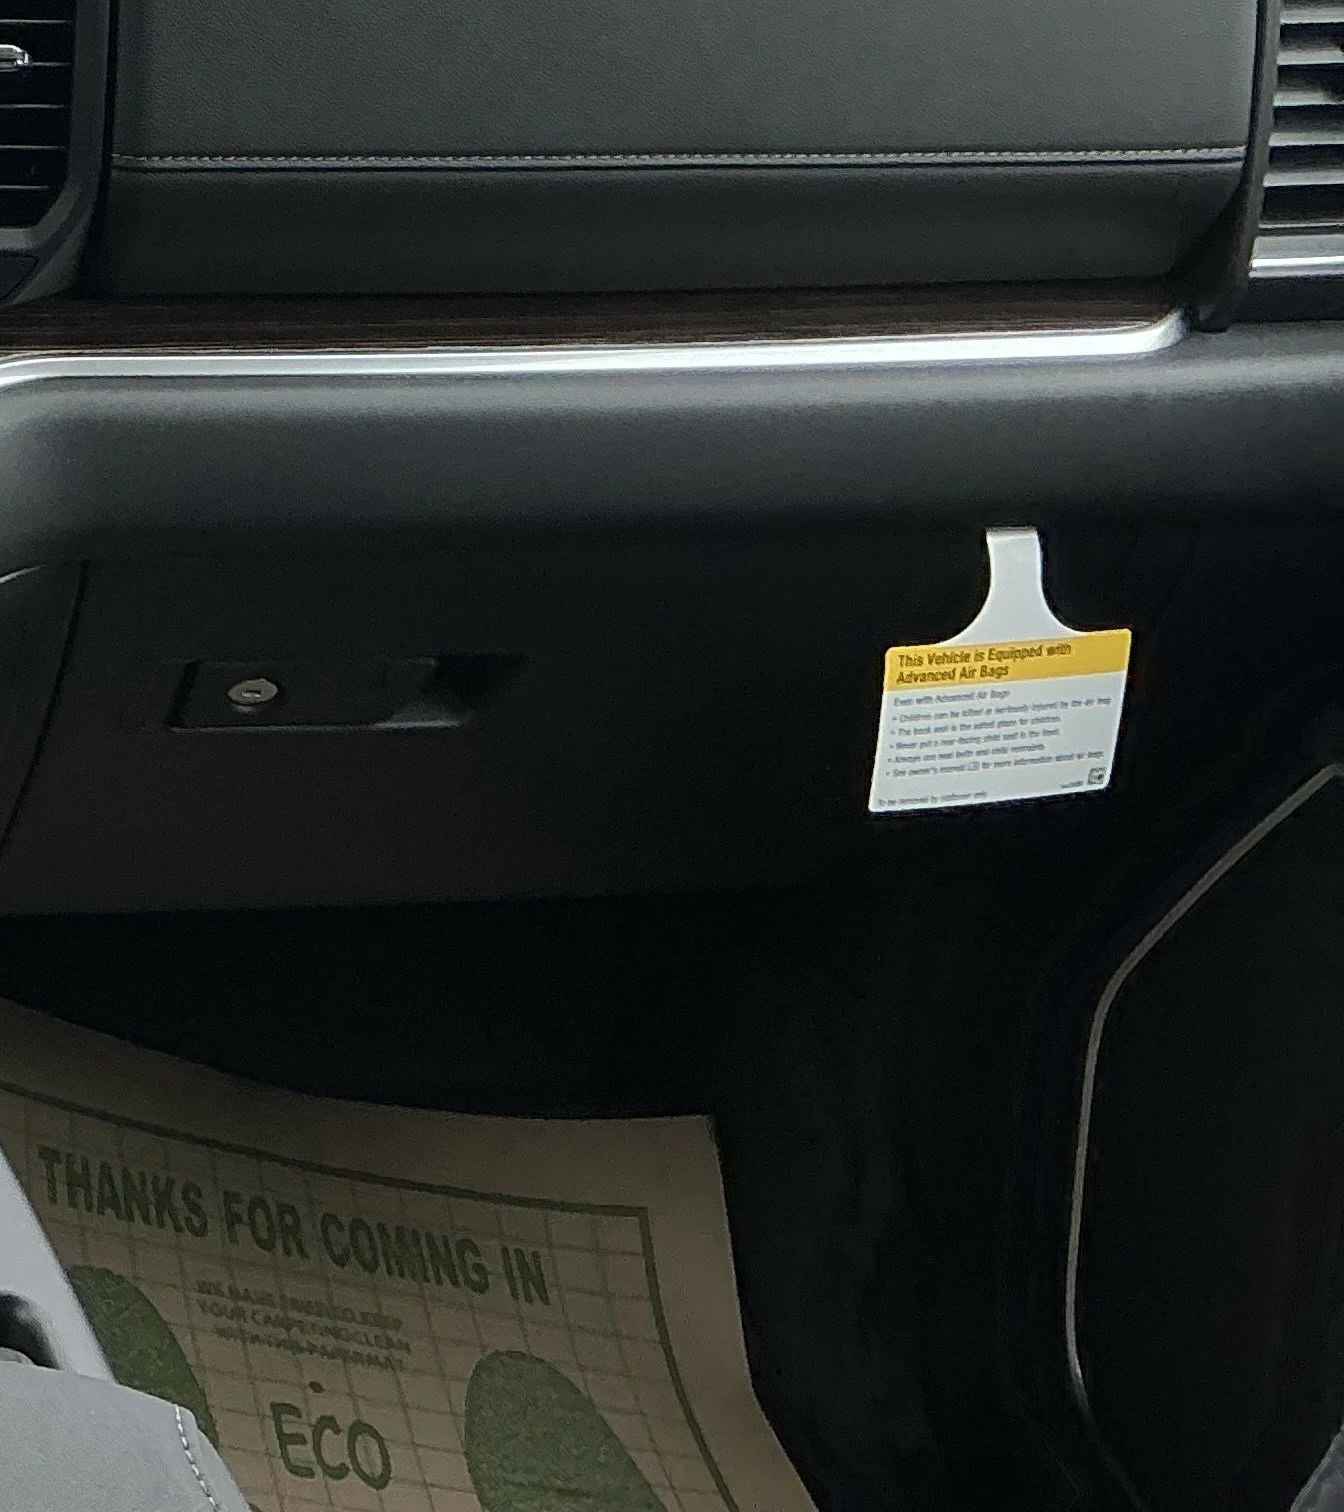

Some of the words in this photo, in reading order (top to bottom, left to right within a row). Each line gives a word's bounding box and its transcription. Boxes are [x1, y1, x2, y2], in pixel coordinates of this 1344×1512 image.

[896, 668, 956, 685] Advanced
[960, 666, 977, 681] Air
[980, 664, 1010, 679] Bags
[898, 654, 924, 668] This
[927, 651, 971, 665] Vehicle
[973, 649, 985, 662] is
[988, 645, 1043, 662] Equipped
[1046, 643, 1072, 655] with
[36, 1144, 210, 1239] THANKS
[222, 1189, 310, 1261] FOR
[320, 1212, 491, 1295] COMING
[500, 1246, 551, 1307] IN
[269, 1401, 393, 1491] ECO
